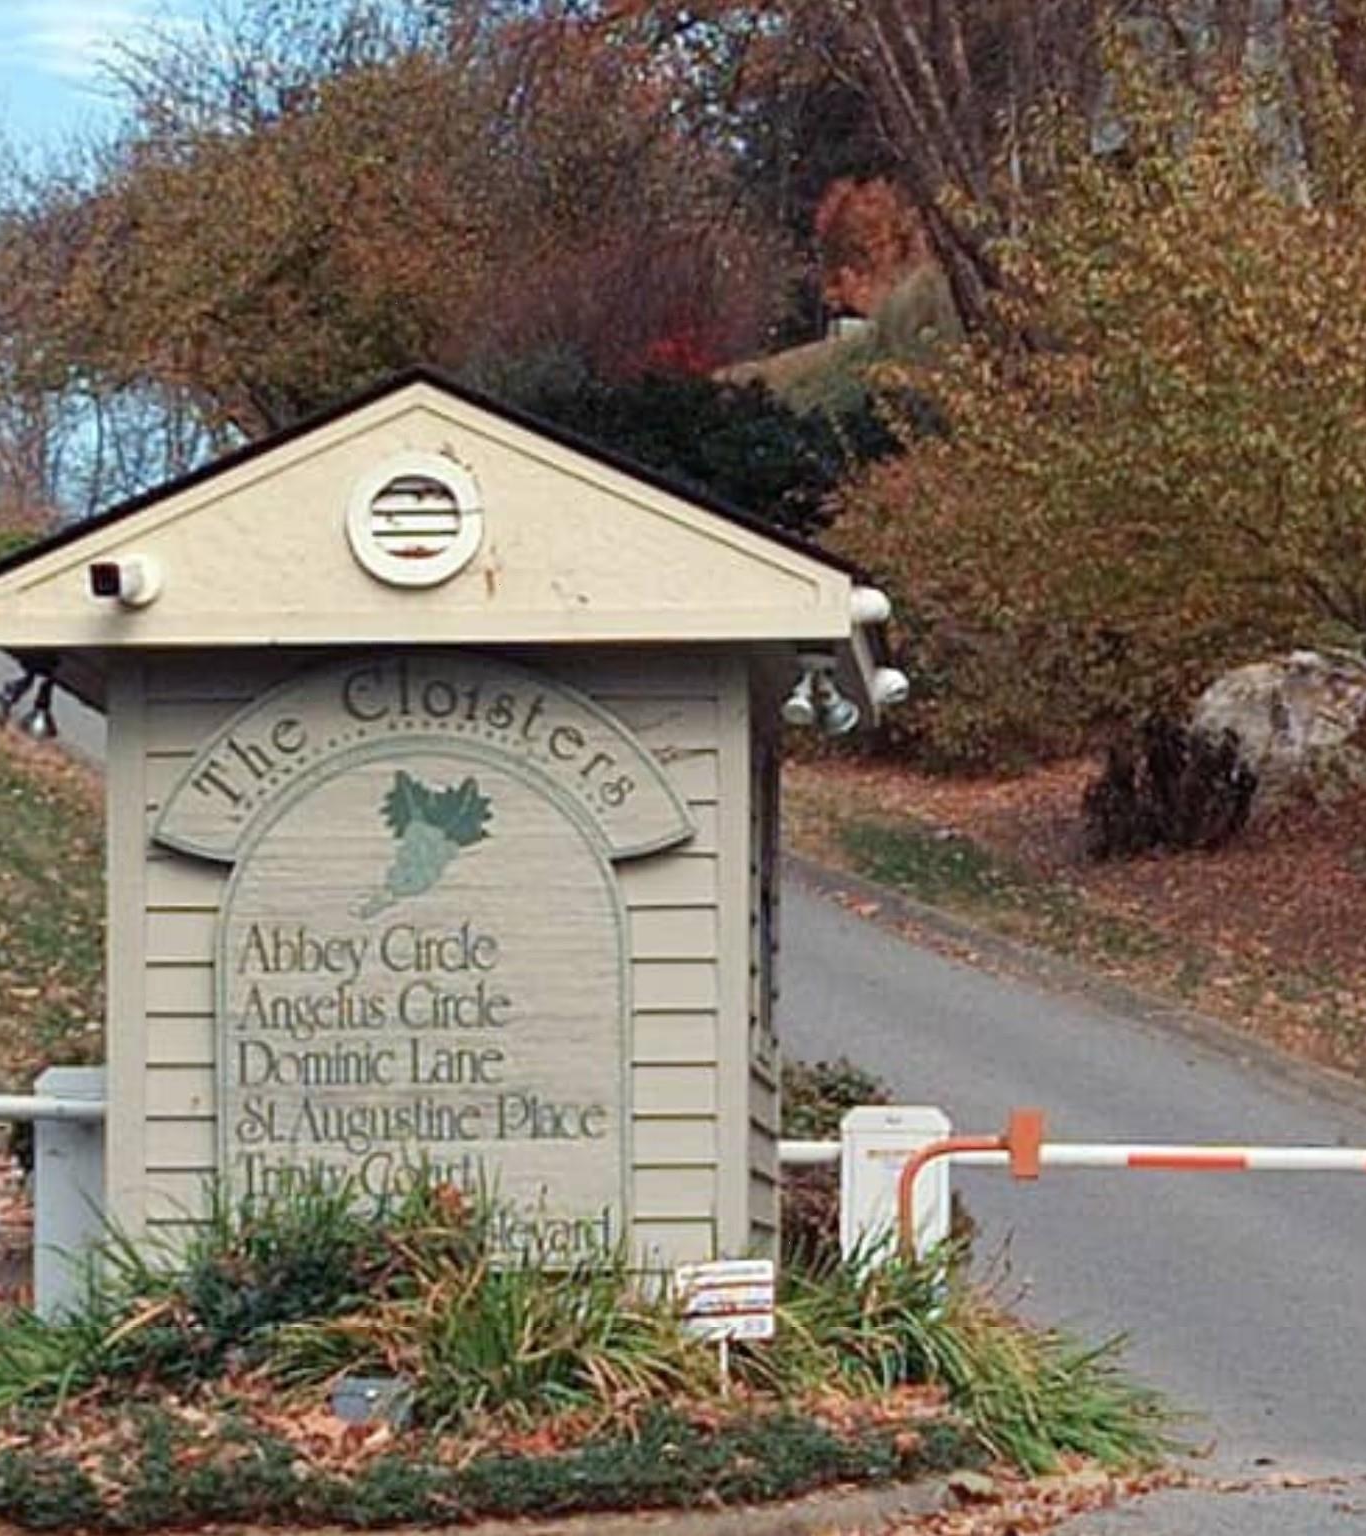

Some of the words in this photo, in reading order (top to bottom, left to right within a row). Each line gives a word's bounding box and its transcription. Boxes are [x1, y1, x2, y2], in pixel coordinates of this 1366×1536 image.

[191, 717, 308, 805] The
[341, 659, 635, 808] Cloisters
[236, 922, 369, 984] Abbey
[380, 921, 499, 973] Circle
[236, 982, 387, 1041] Angelus
[398, 979, 513, 1030] Circle
[236, 1038, 397, 1087] Dominic
[409, 1038, 506, 1085] Lane
[289, 1096, 482, 1156] Augustine
[496, 1093, 610, 1142] Place
